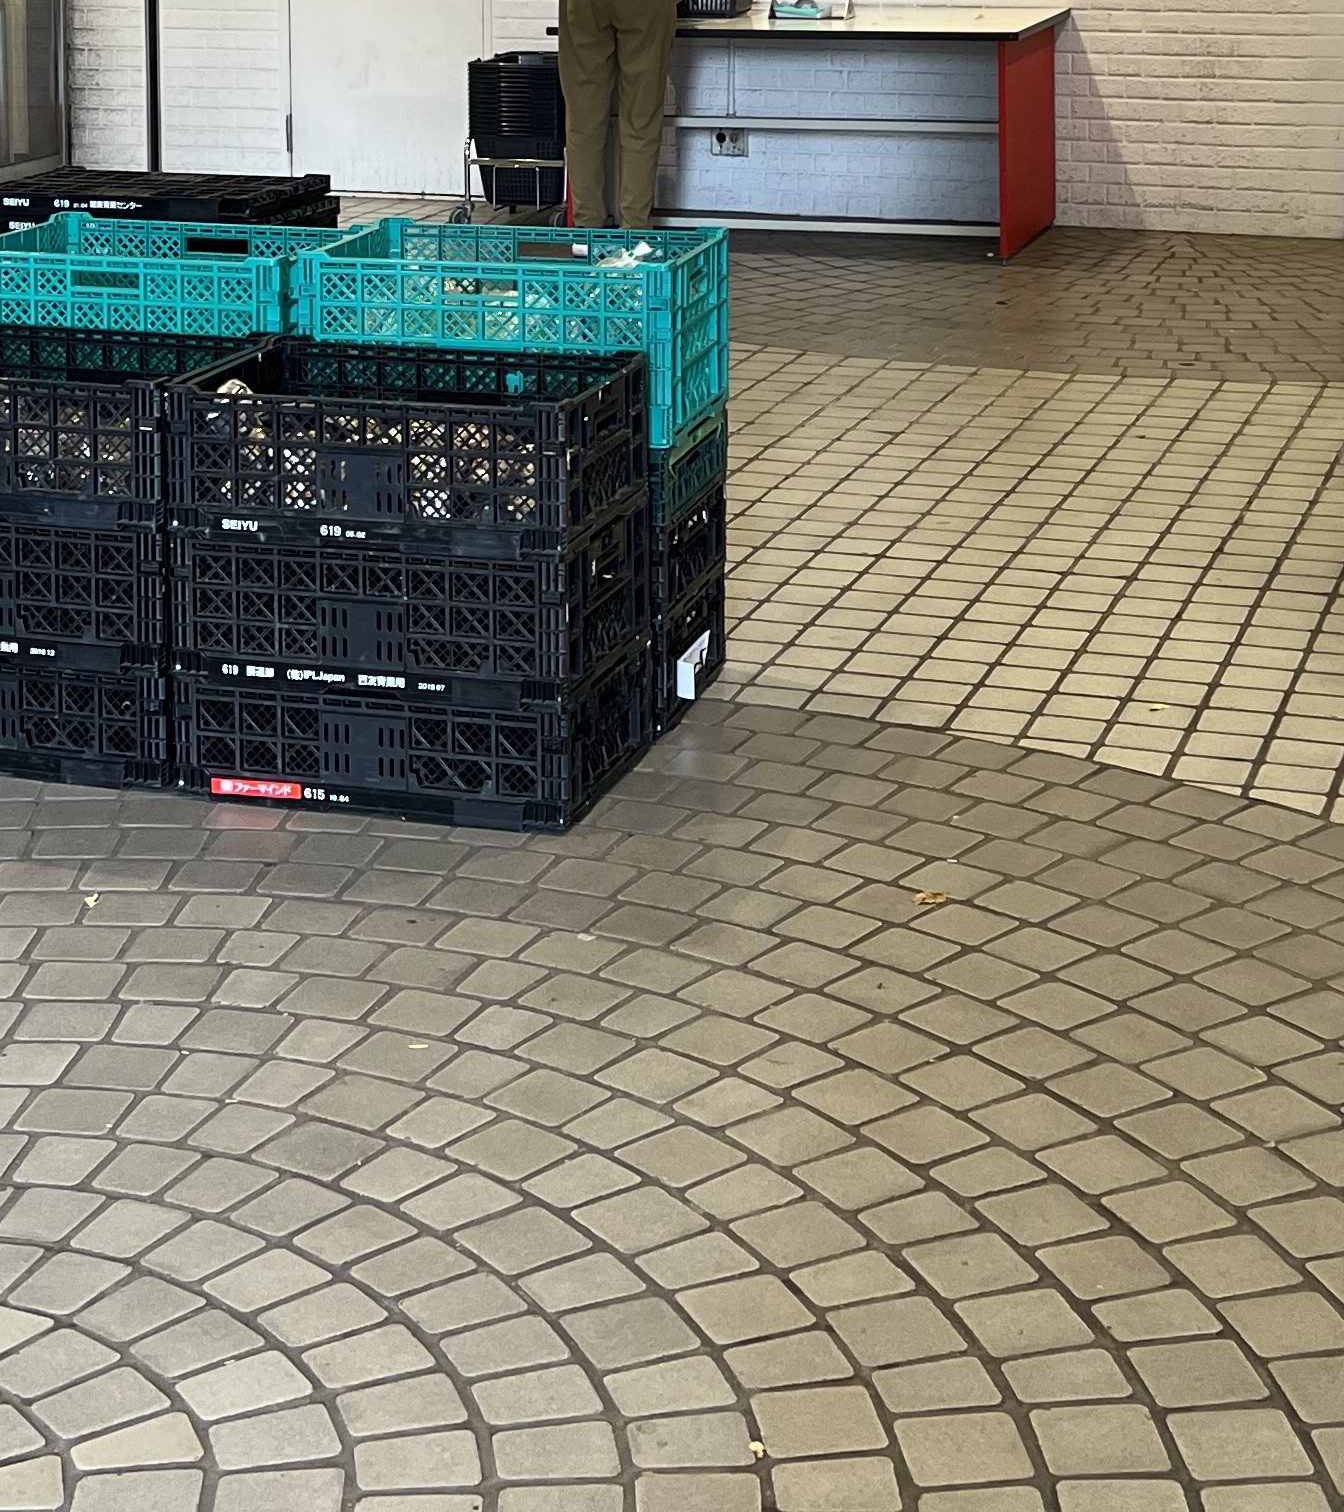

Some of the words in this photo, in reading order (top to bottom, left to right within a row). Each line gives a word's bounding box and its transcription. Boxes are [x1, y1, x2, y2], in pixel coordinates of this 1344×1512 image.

[2, 197, 30, 207] SEIYU
[221, 518, 259, 532] SEIYU
[319, 524, 342, 537] 619
[303, 787, 326, 801] 615
